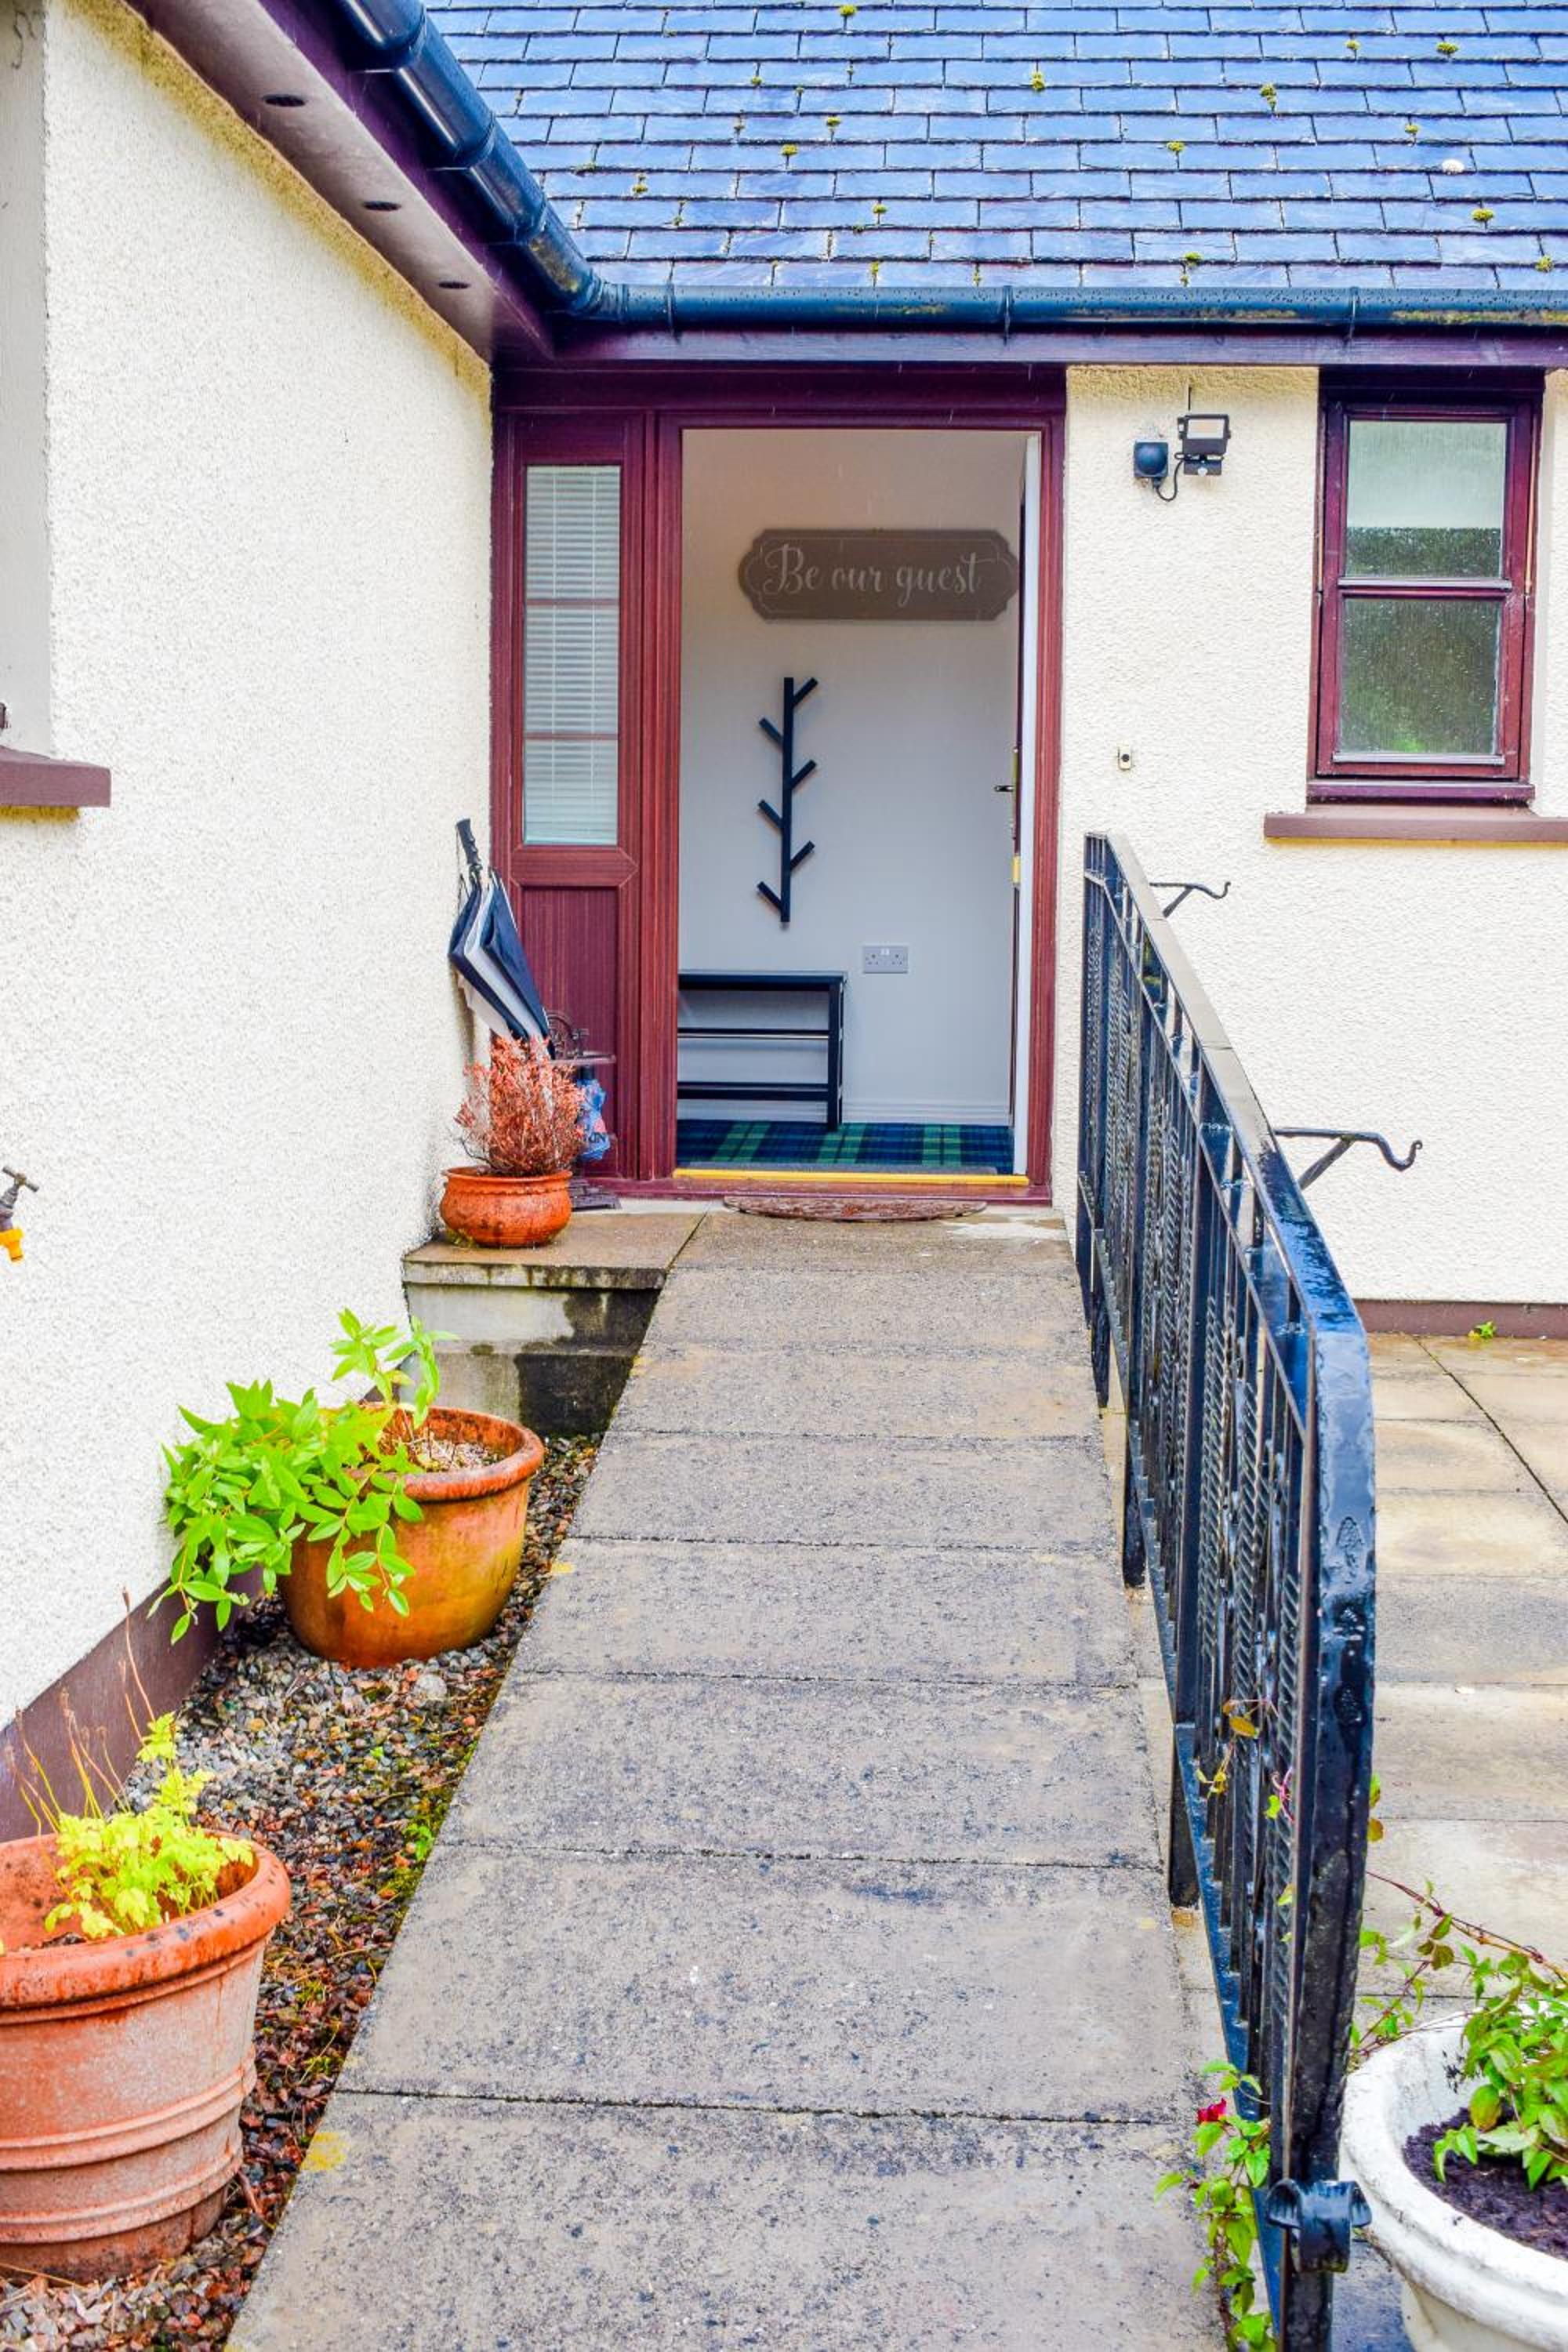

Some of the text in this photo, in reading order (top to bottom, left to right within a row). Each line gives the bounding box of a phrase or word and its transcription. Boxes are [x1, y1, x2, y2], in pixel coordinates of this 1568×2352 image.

[763, 544, 994, 608] Be our guest
